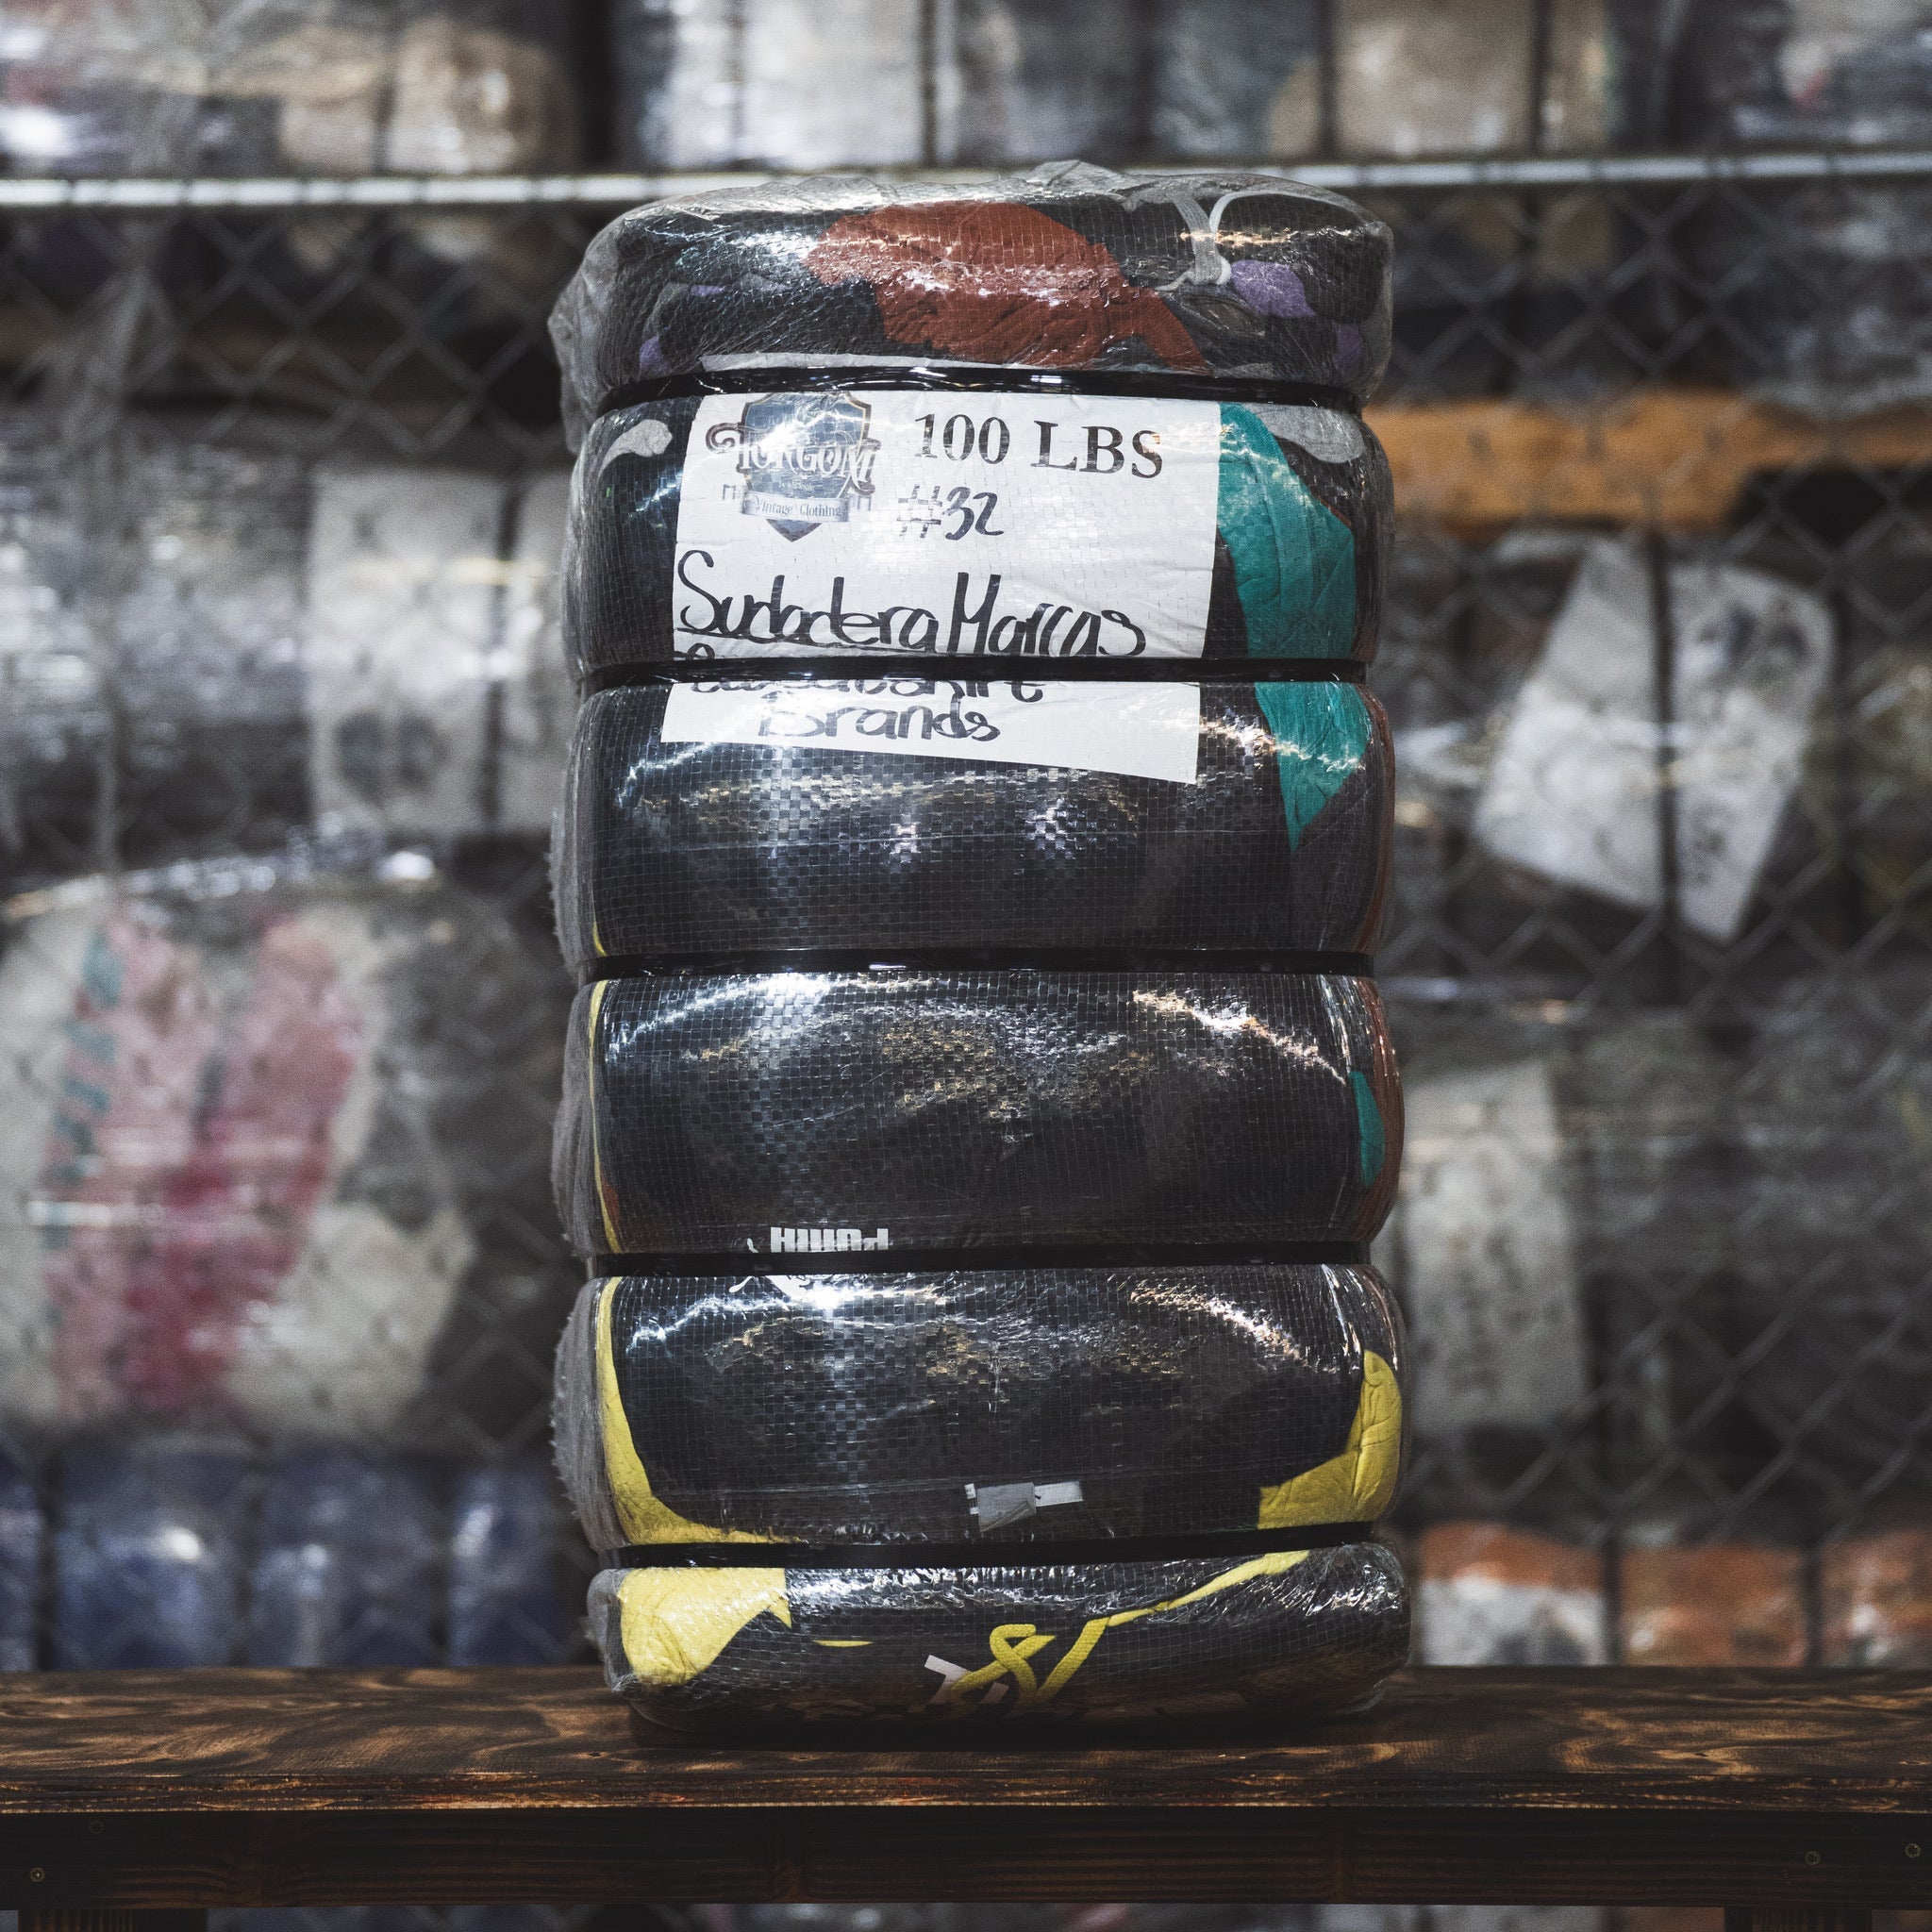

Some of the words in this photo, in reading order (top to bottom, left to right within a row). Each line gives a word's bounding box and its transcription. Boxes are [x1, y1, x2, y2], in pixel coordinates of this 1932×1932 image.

[913, 413, 1010, 465] 100
[1030, 419, 1163, 478] LBS
[754, 496, 793, 518] Vintage
[799, 502, 842, 519] Clothing
[897, 483, 1004, 541] #32
[676, 549, 937, 653] Sudadera
[947, 572, 1146, 658] Marcas
